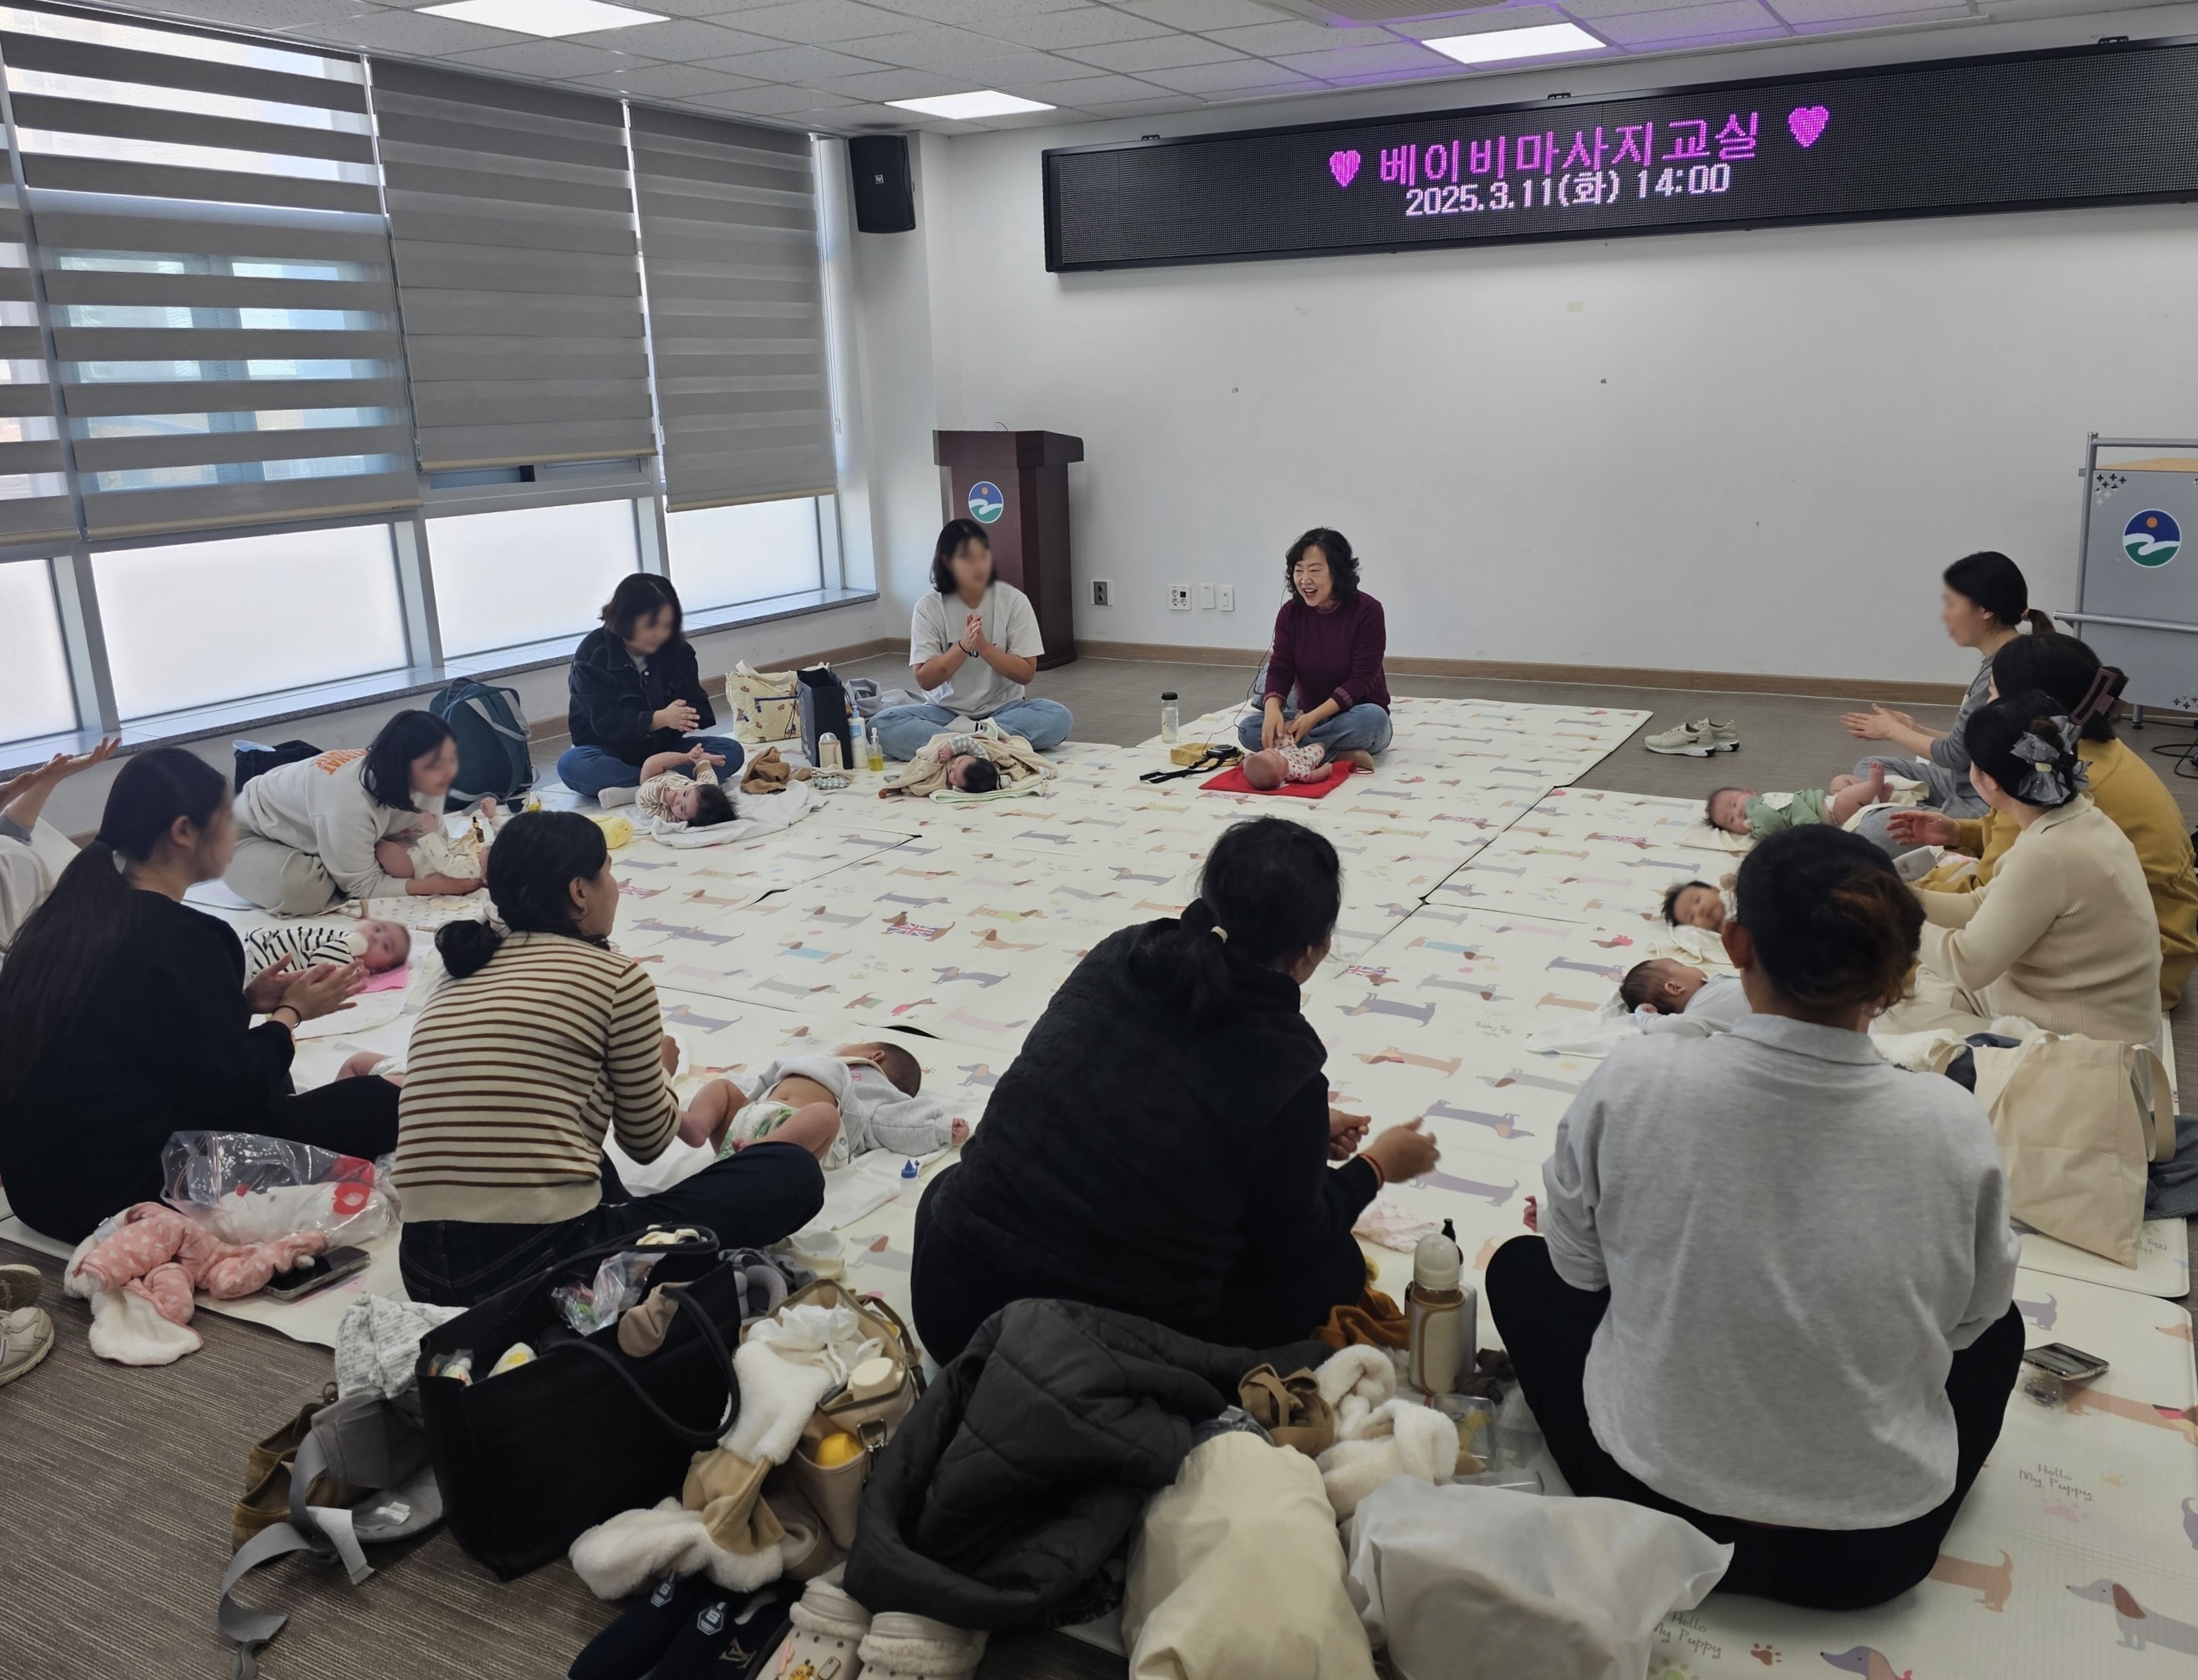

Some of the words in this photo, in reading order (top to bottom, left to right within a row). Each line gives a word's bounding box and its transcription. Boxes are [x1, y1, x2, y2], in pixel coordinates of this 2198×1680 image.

[1406, 170, 1620, 217] 2025.3.11(화)
[1637, 163, 1731, 199] 14:00
[2019, 1470, 2043, 1488] My
[2049, 1477, 2093, 1501] Puppy
[2038, 1463, 2073, 1480] Hello
[1671, 1611, 1707, 1632] Hello
[1679, 1628, 1722, 1660] Puppy
